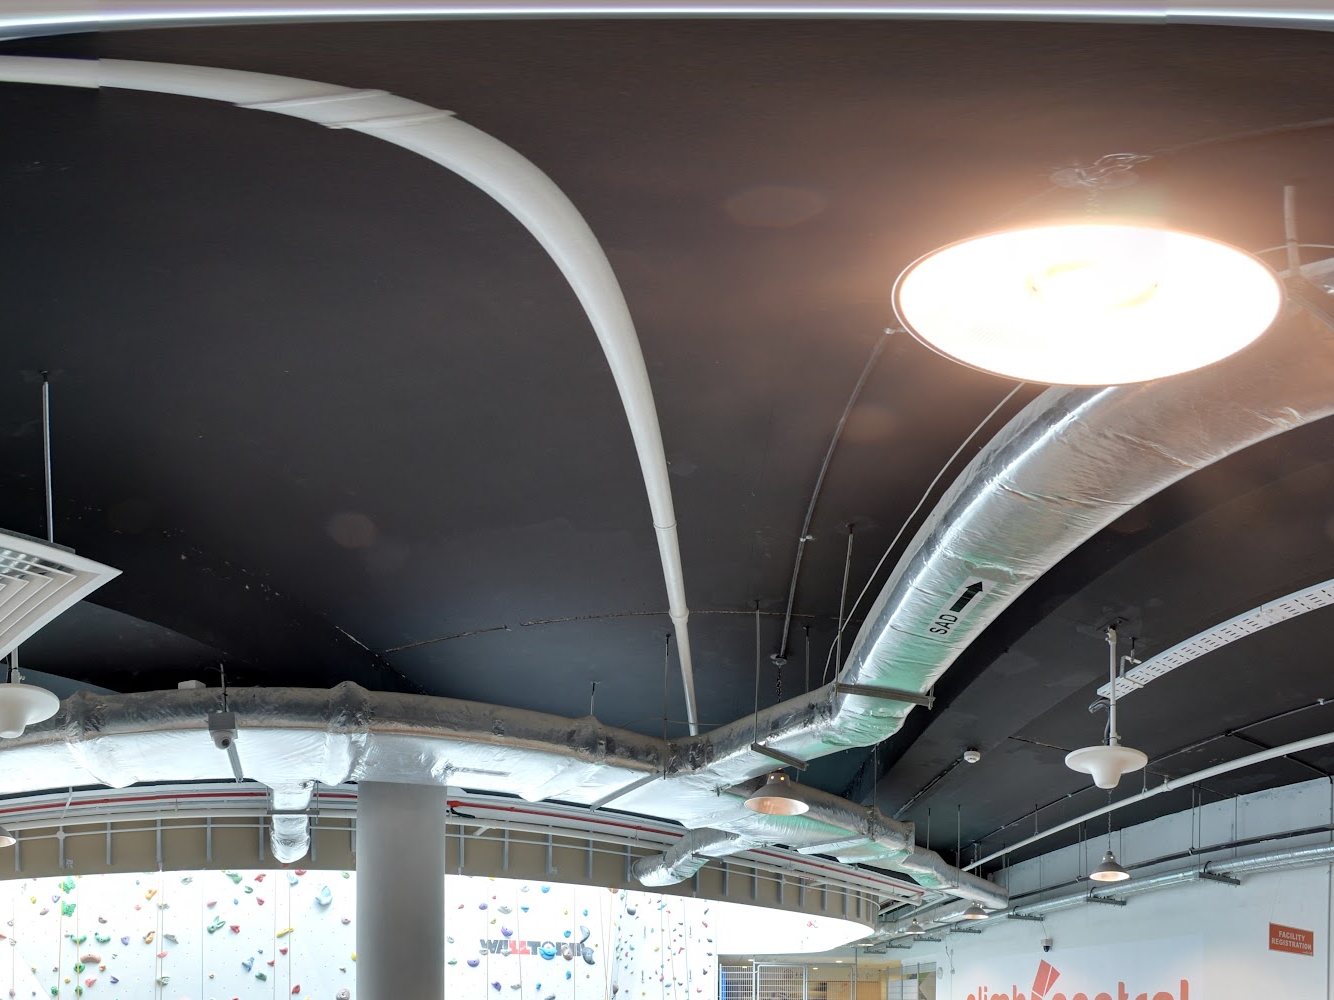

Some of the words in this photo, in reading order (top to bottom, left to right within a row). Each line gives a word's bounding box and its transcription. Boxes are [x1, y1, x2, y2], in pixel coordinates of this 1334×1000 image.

[930, 614, 958, 634] SAD
[1279, 931, 1305, 941] FACILITY
[1272, 938, 1311, 950] REGISTRATION
